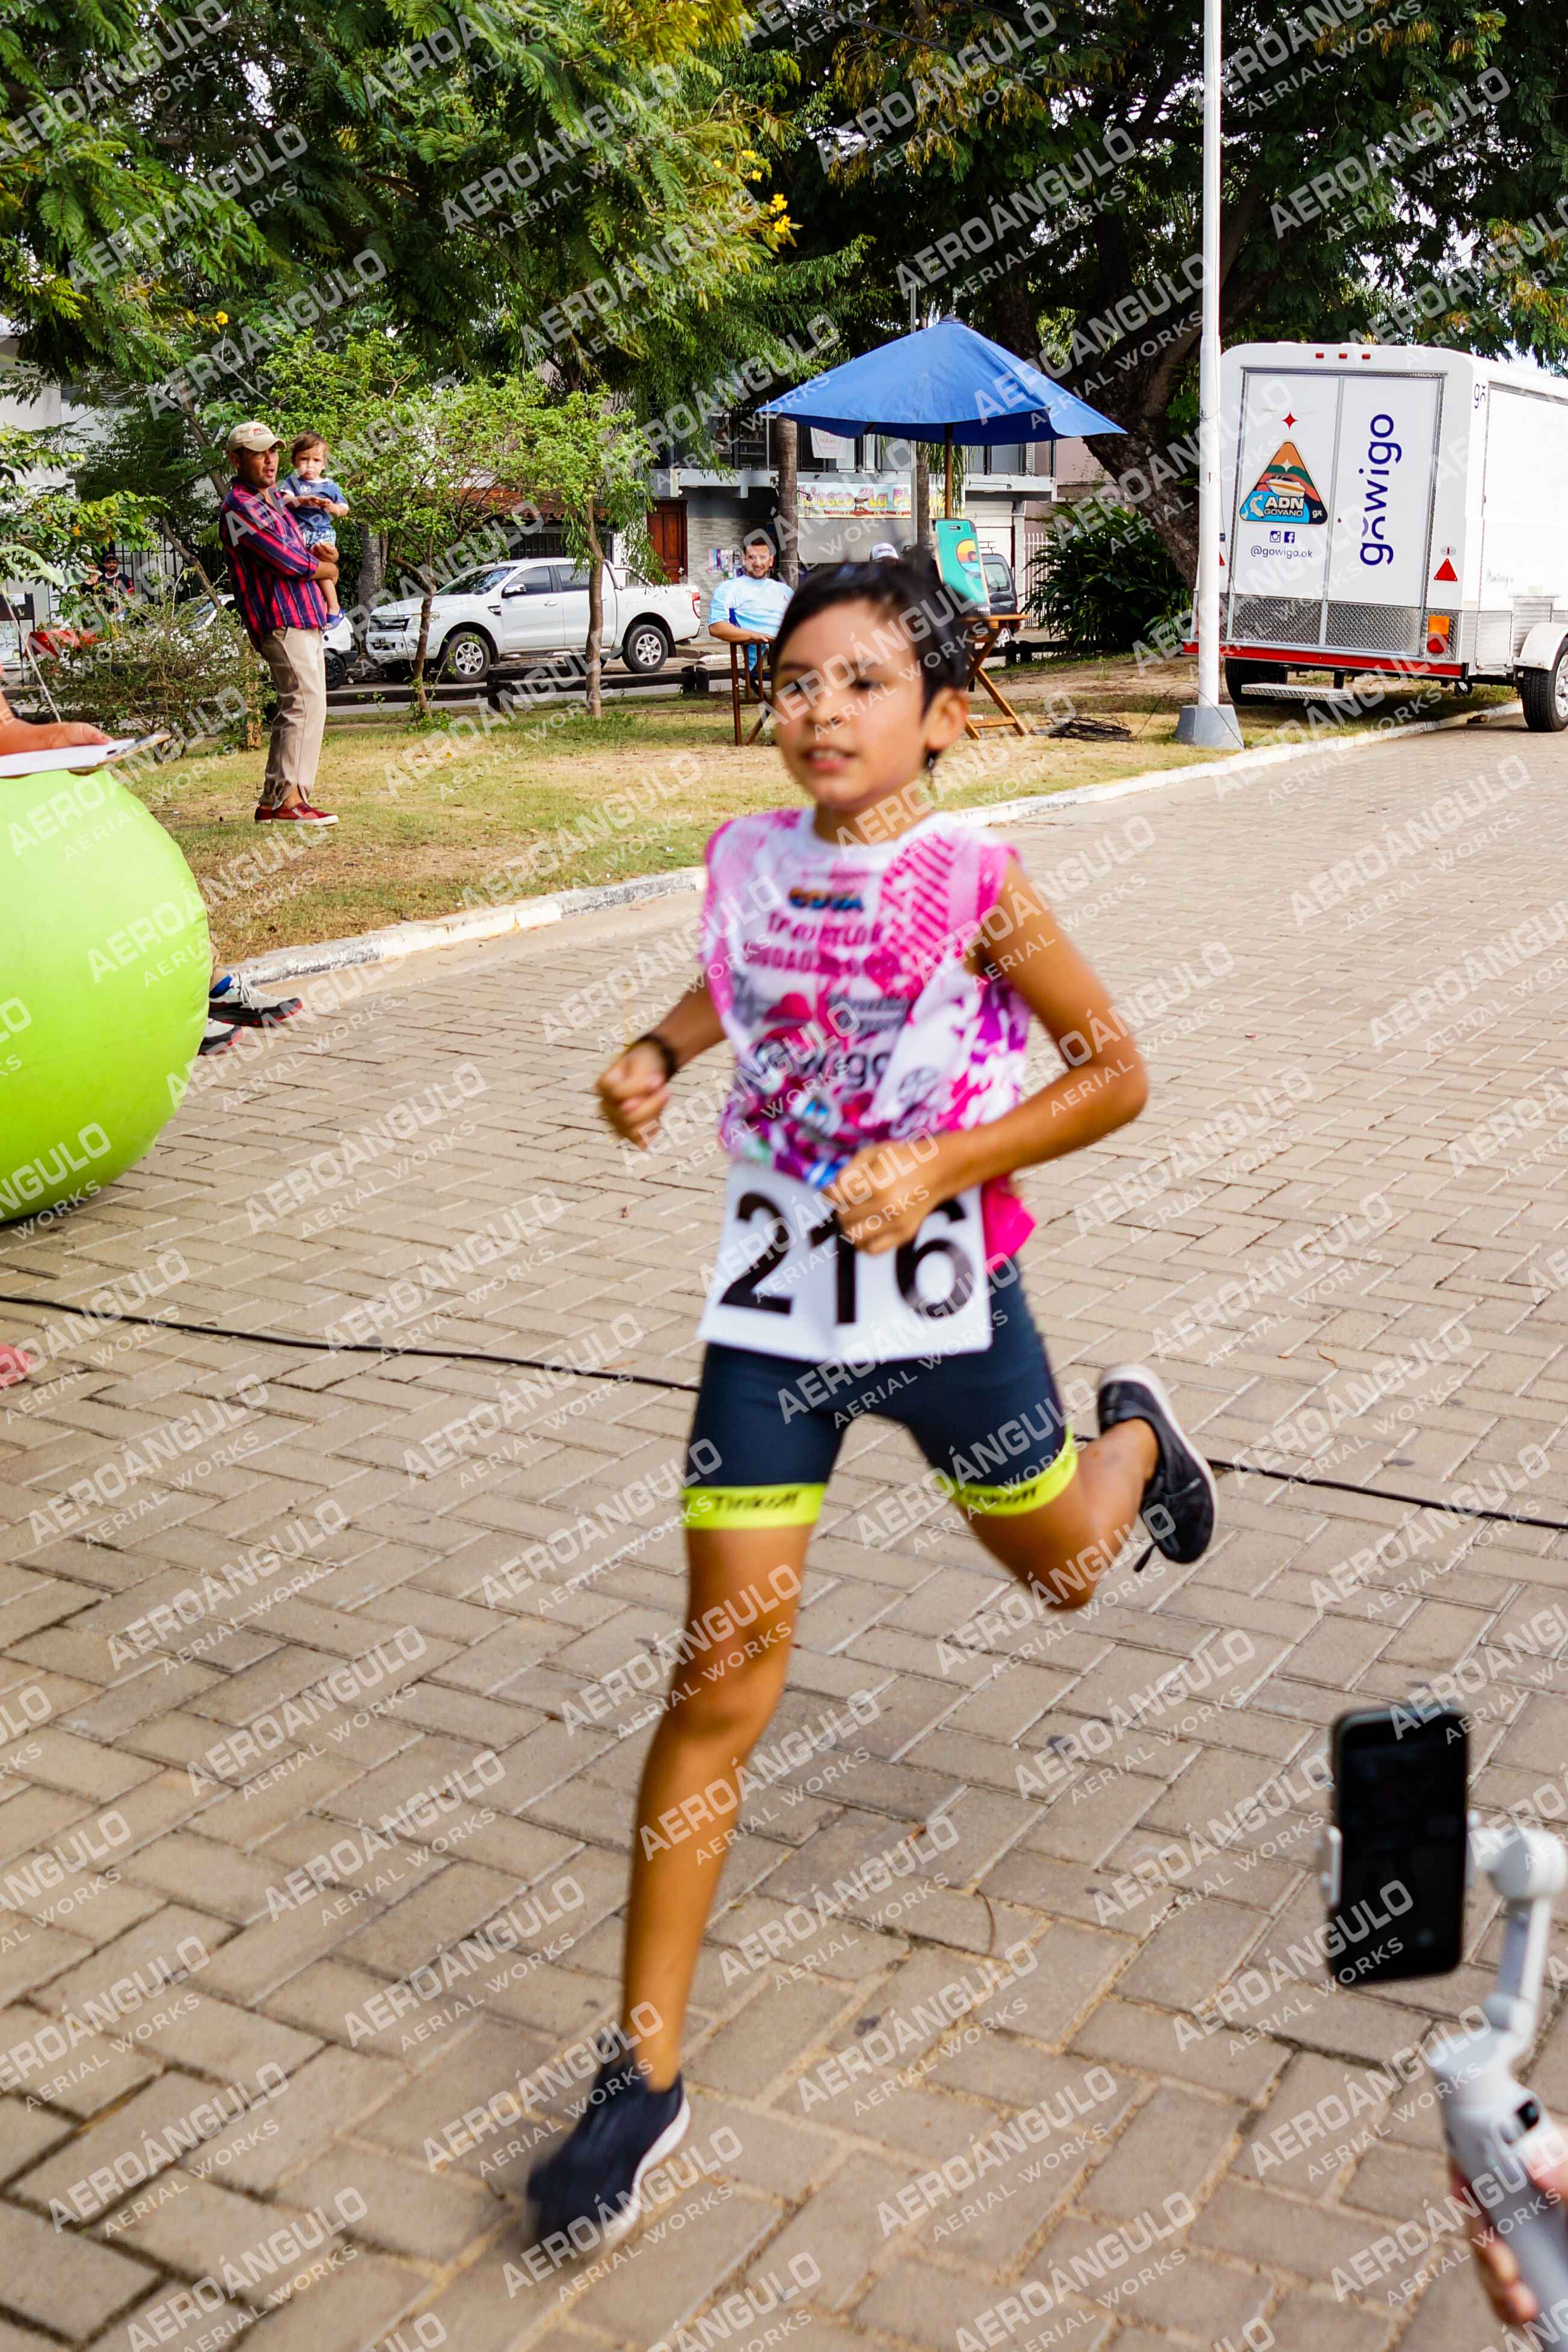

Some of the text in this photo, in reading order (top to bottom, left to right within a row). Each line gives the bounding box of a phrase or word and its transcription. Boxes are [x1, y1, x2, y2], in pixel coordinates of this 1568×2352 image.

[1265, 496, 1304, 509] ADN
[1264, 508, 1303, 517] GOYANO
[1250, 545, 1314, 559] @gowigo.ok
[718, 1192, 975, 1325] 216
